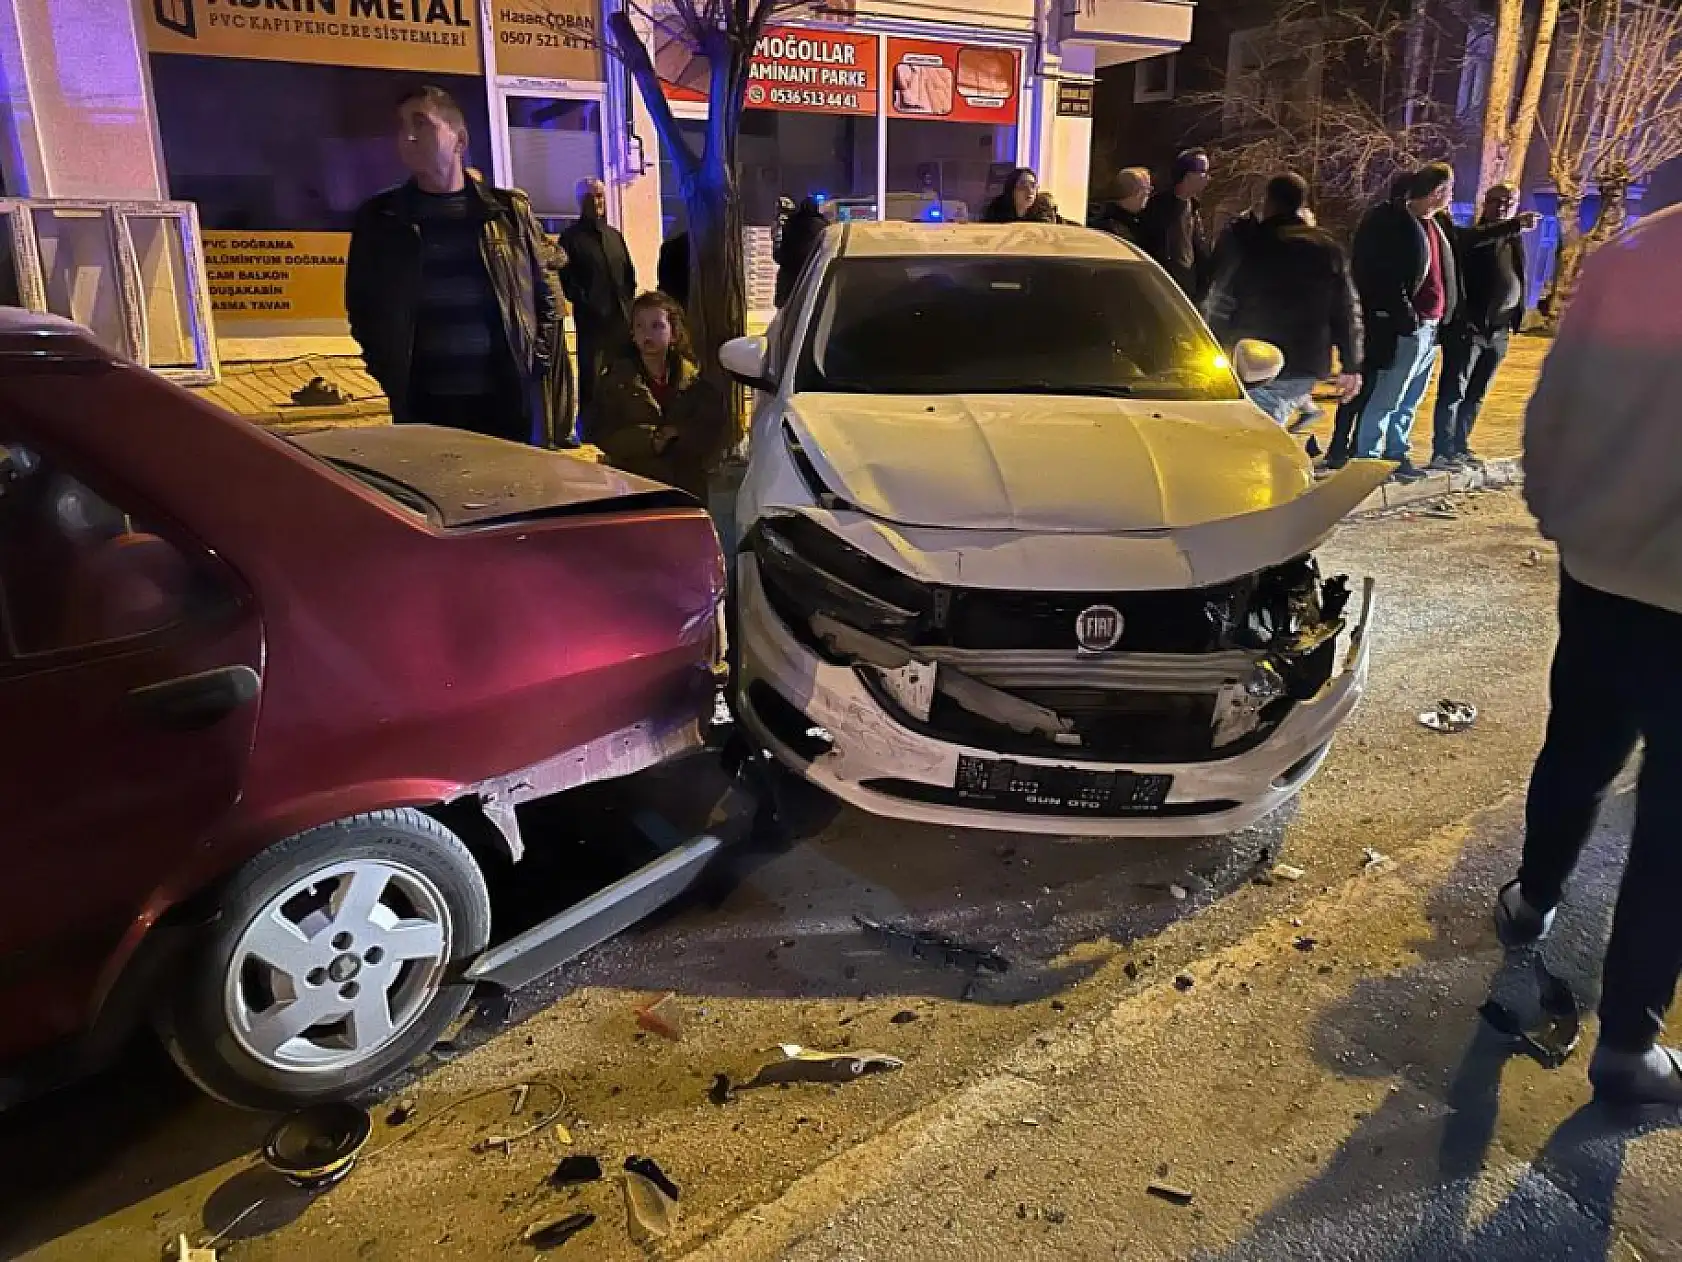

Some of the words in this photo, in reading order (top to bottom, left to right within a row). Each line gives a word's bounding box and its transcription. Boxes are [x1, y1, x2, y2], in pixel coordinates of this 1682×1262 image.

[209, 12, 245, 28] PVC
[249, 16, 290, 32] KAPI
[294, 19, 371, 37] PENCERE
[374, 24, 467, 47] SİSTEMLERİ
[500, 30, 533, 46] 0507
[536, 32, 559, 48] 521
[752, 34, 856, 65] MOĞOLLAR
[748, 61, 818, 84] AMİNANT
[821, 68, 867, 88] PARKE
[770, 87, 801, 104] 0536
[231, 238, 296, 249] DOĞRAMA
[205, 254, 281, 264] ALÜMİNYUM
[284, 254, 346, 266] DOĞRAMA
[207, 270, 235, 280] CAM
[238, 270, 290, 280] BALKON
[209, 285, 283, 296] DUŞAKABİN
[251, 301, 290, 310] TAVAN
[1087, 617, 1114, 638] FIAT
